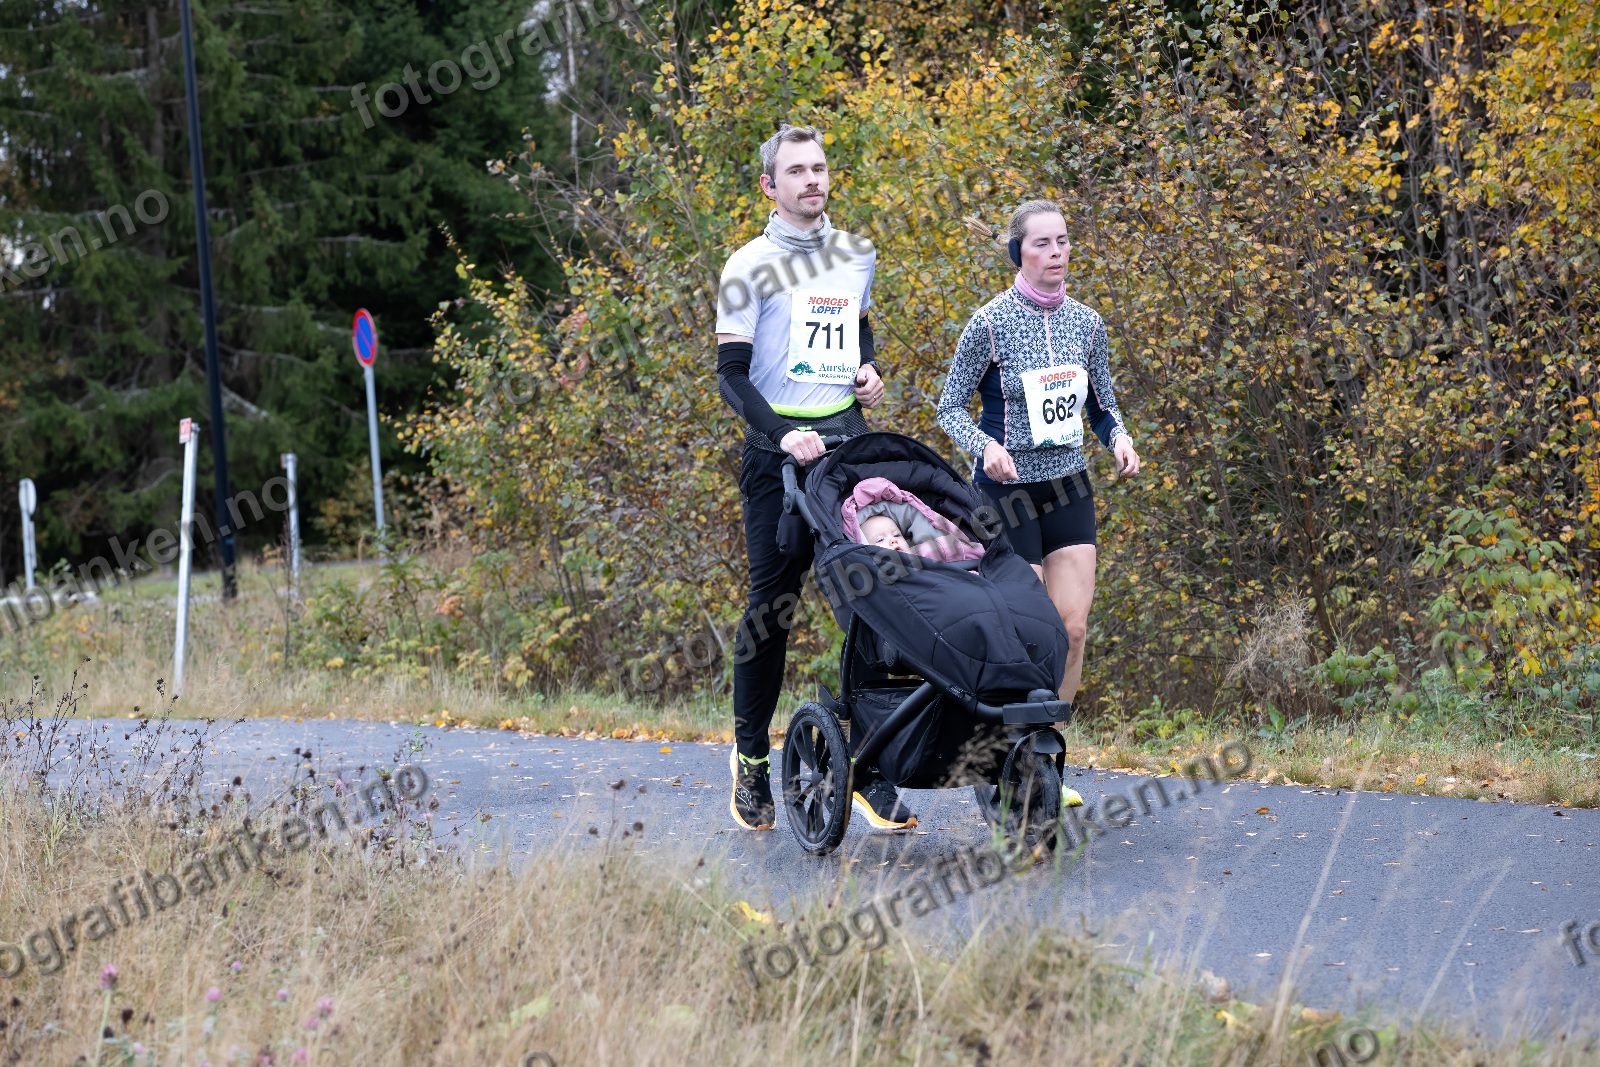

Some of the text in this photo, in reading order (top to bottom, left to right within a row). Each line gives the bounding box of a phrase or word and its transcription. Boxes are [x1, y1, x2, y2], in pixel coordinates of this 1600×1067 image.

[808, 296, 848, 307] NORGES
[811, 305, 843, 314] LØPET
[805, 322, 843, 349] 711
[1040, 371, 1077, 383] NORGES
[1045, 379, 1073, 391] LØPET
[1043, 394, 1077, 424] 662
